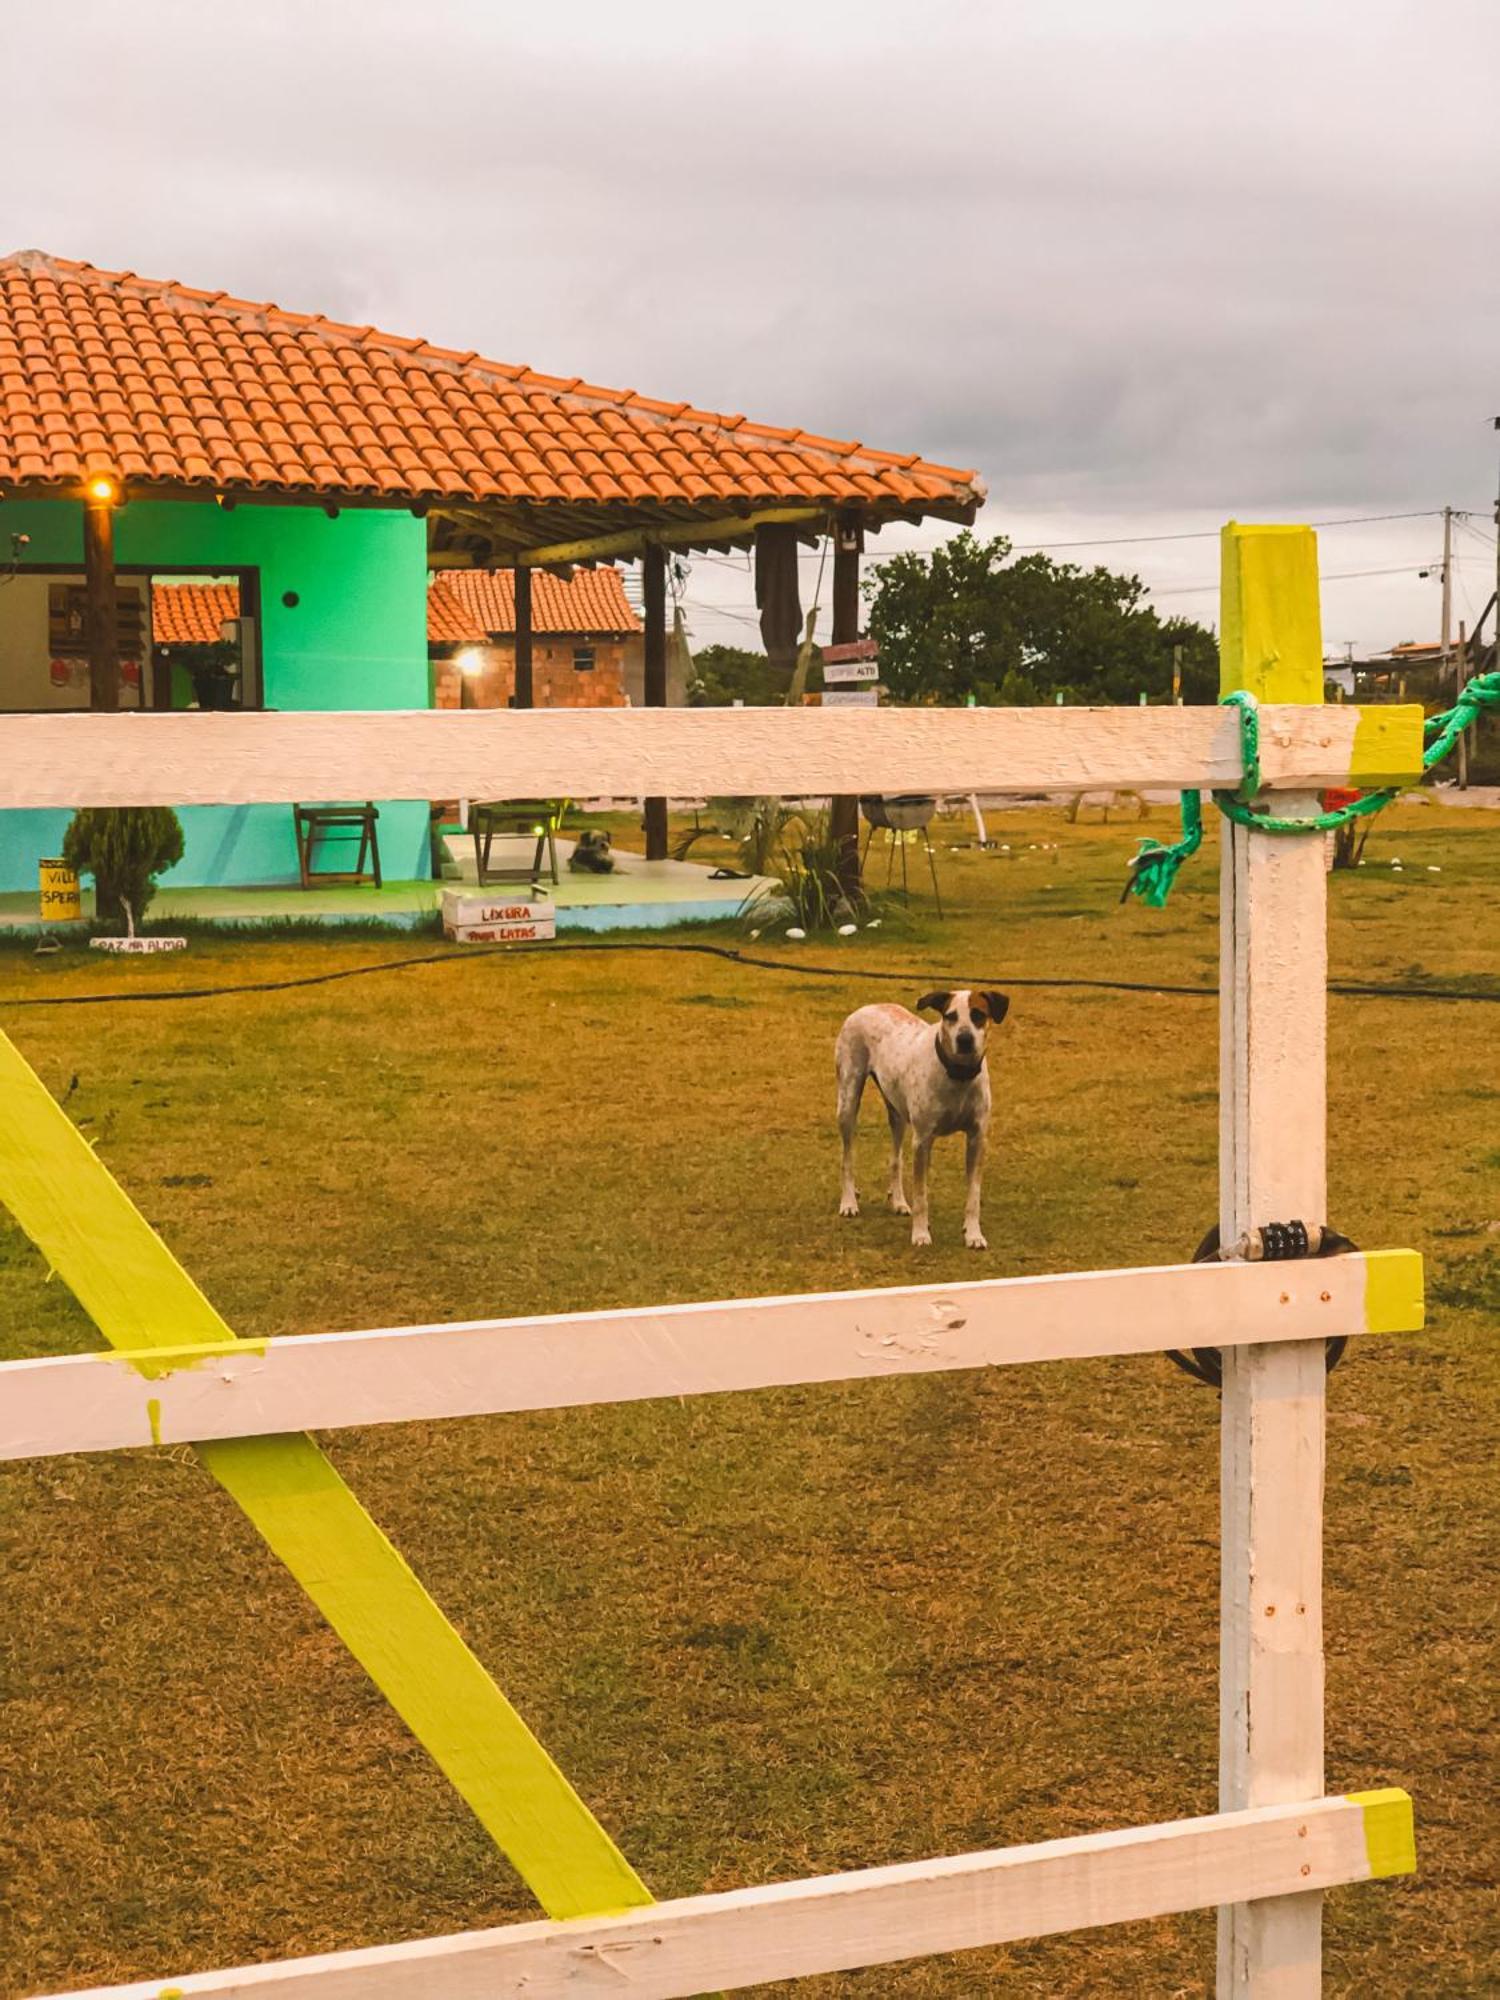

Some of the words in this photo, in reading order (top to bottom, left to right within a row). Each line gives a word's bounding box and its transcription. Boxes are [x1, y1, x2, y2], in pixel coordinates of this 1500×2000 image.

[500, 926, 536, 940] LATAS
[98, 940, 124, 951] PAZ
[147, 939, 184, 950] ALMA
